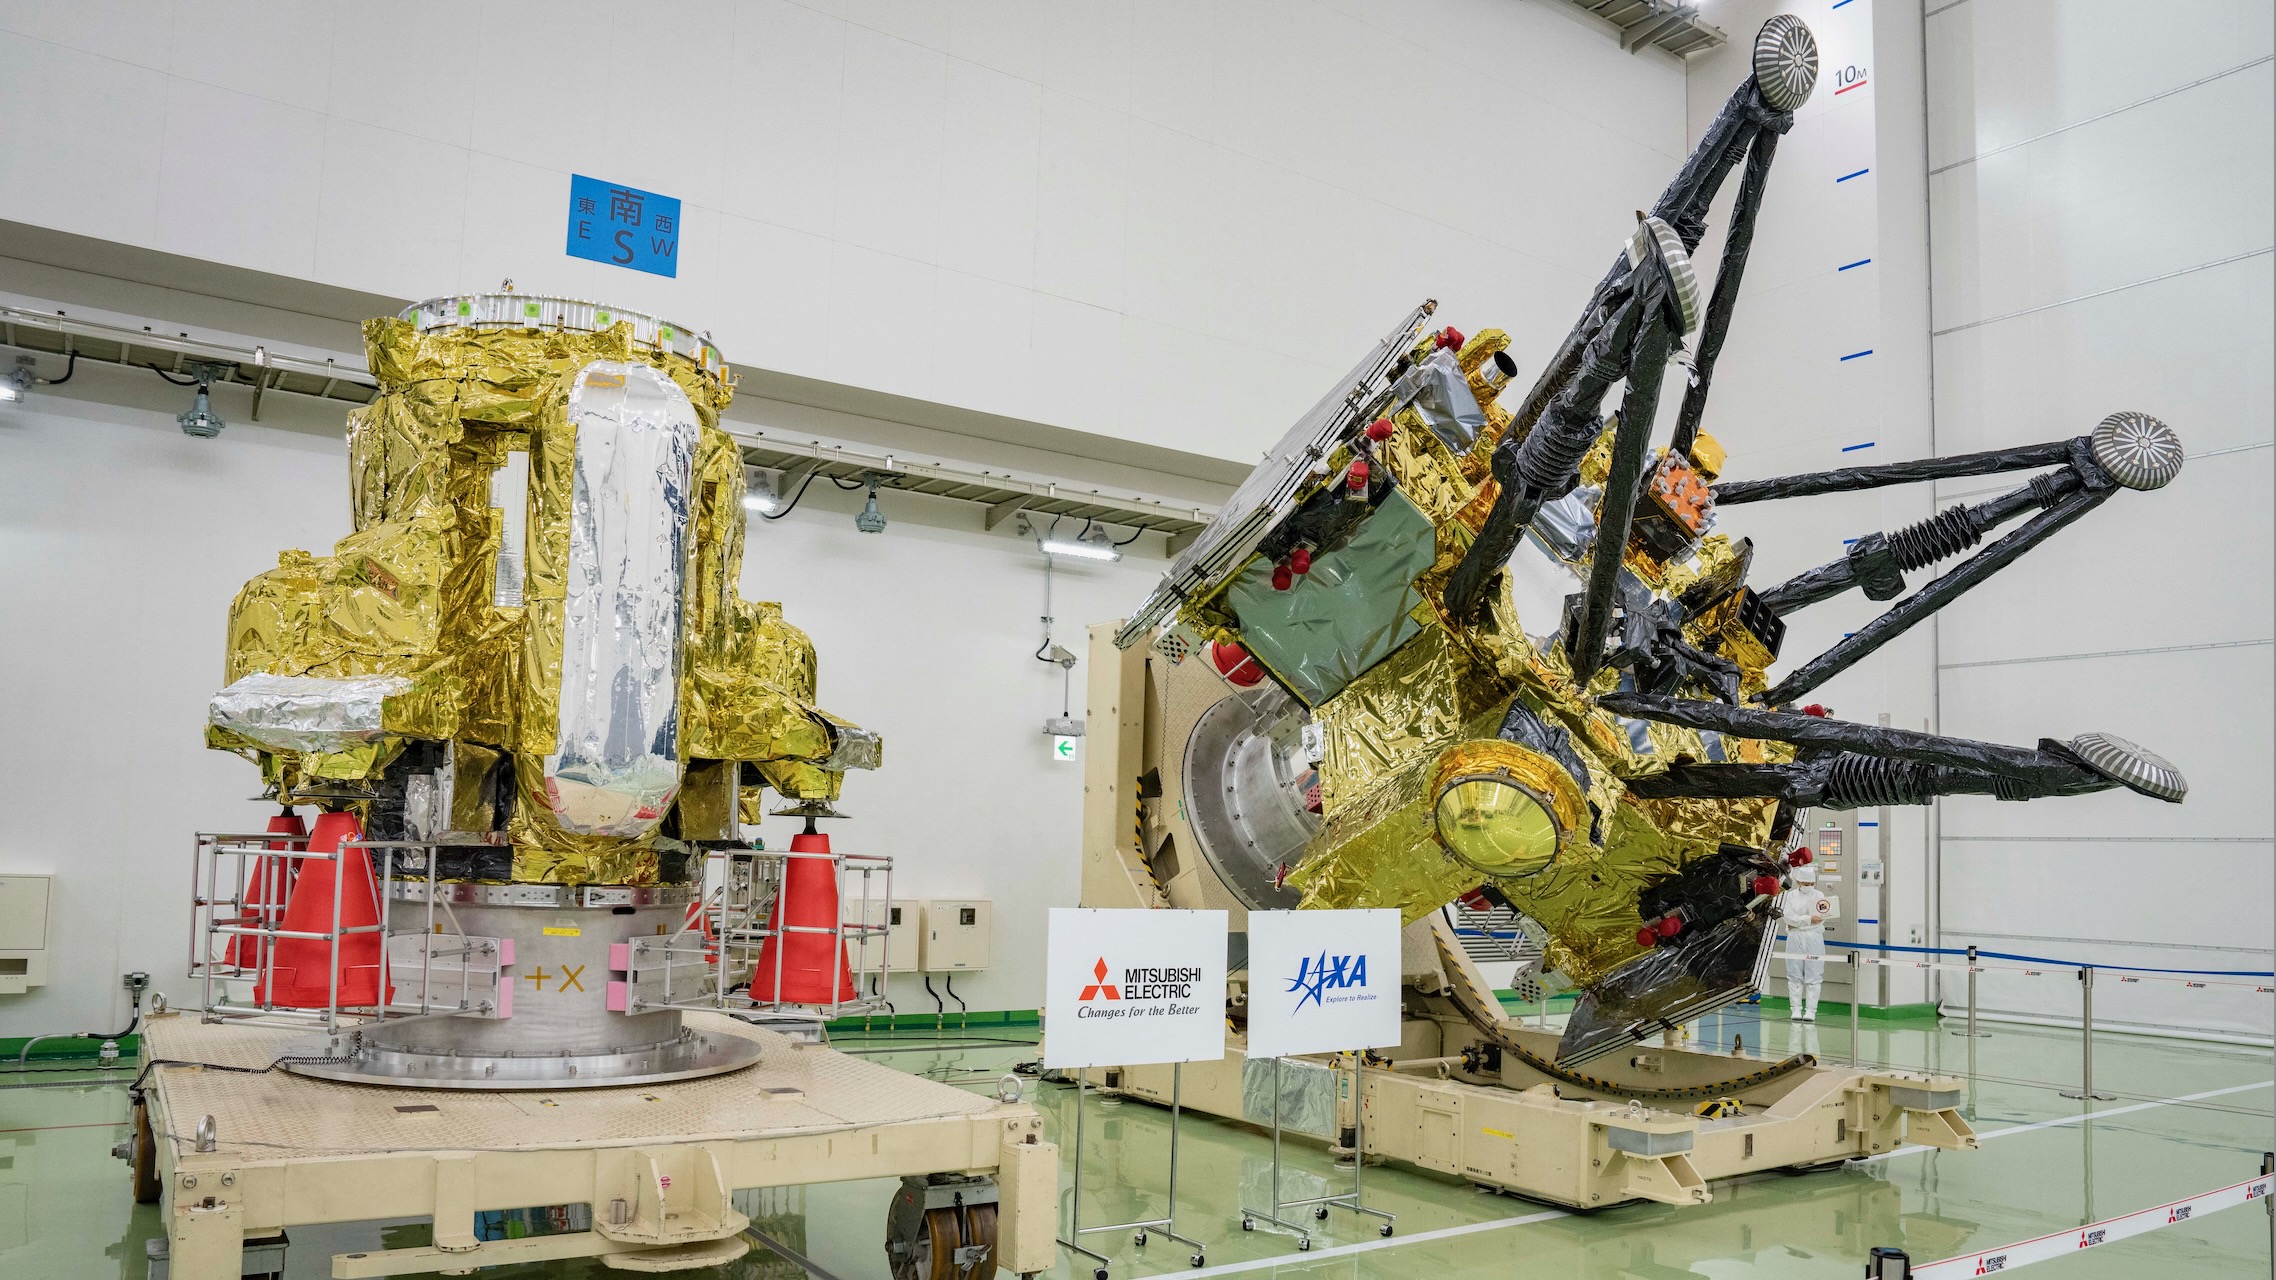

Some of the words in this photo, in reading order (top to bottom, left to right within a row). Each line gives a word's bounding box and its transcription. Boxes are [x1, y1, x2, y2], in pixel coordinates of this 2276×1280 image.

[578, 197, 596, 216] 東
[610, 189, 645, 226] 南
[655, 214, 673, 234] 西
[578, 219, 592, 240] E
[611, 229, 634, 264] S
[650, 236, 675, 257] W
[1125, 967, 1201, 984] MITSUBISHI
[1282, 949, 1366, 1010] JAXA
[1124, 983, 1191, 1000] ELECTRIC
[1325, 996, 1348, 1004] Explore
[1077, 1005, 1126, 1020] Changes
[1128, 1006, 1146, 1018] for
[1148, 1006, 1165, 1016] the
[1168, 1003, 1200, 1015] Better
